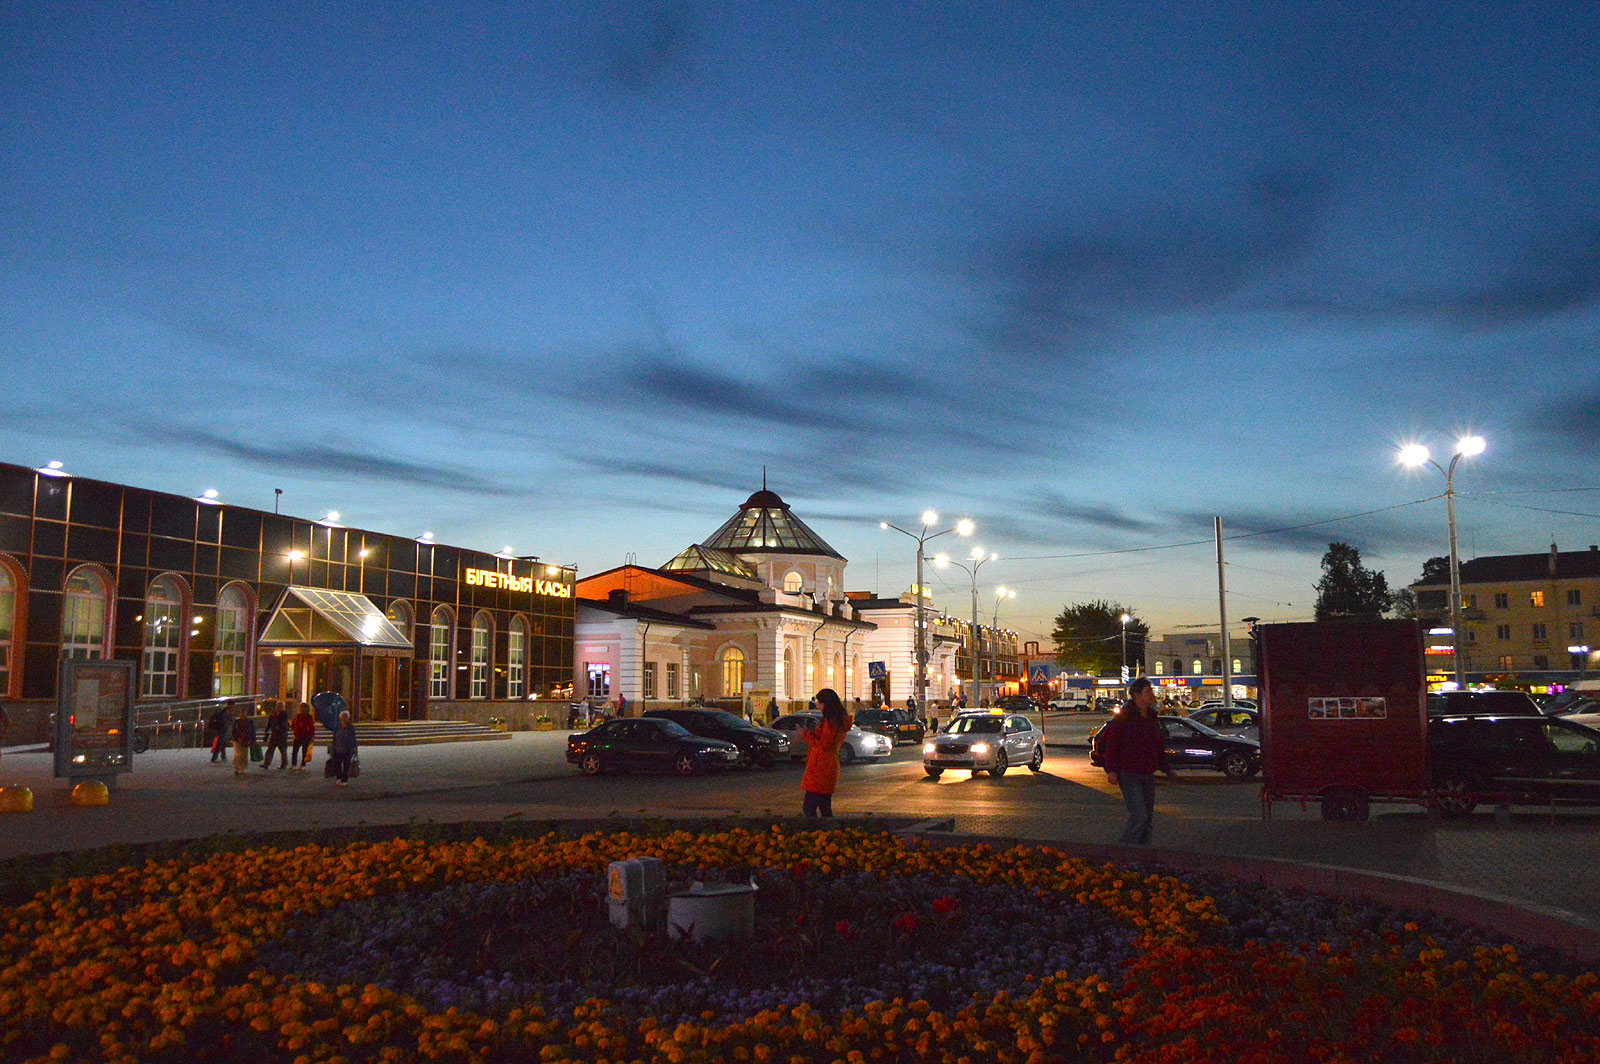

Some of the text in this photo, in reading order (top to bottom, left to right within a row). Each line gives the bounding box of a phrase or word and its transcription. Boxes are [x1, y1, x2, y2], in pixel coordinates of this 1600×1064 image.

[466, 568, 571, 599] БІЛЕТНЫЯ КАСЫ
[1159, 678, 1186, 686] ЦВЕЫ
